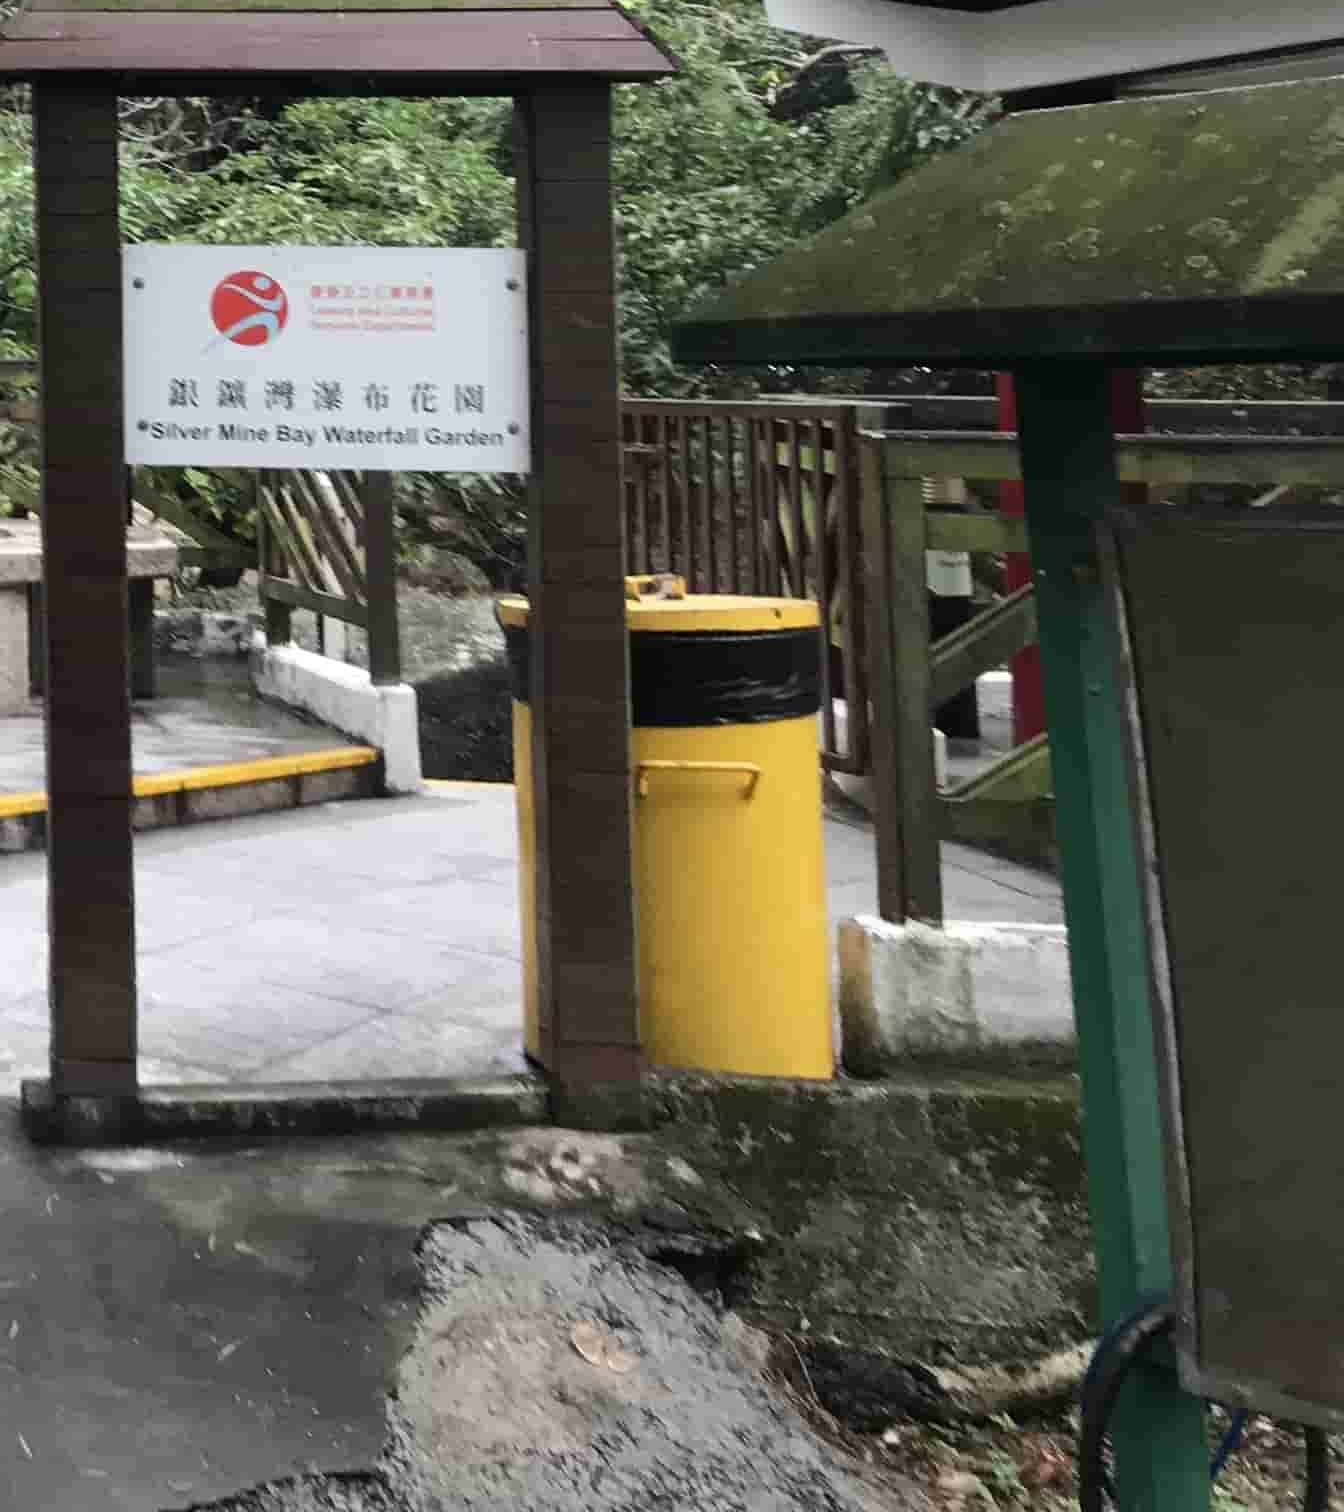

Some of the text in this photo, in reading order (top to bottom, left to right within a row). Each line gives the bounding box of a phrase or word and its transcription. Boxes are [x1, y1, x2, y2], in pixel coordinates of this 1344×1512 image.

[150, 421, 505, 447] Silver Mine Bay Waterfall Garden
